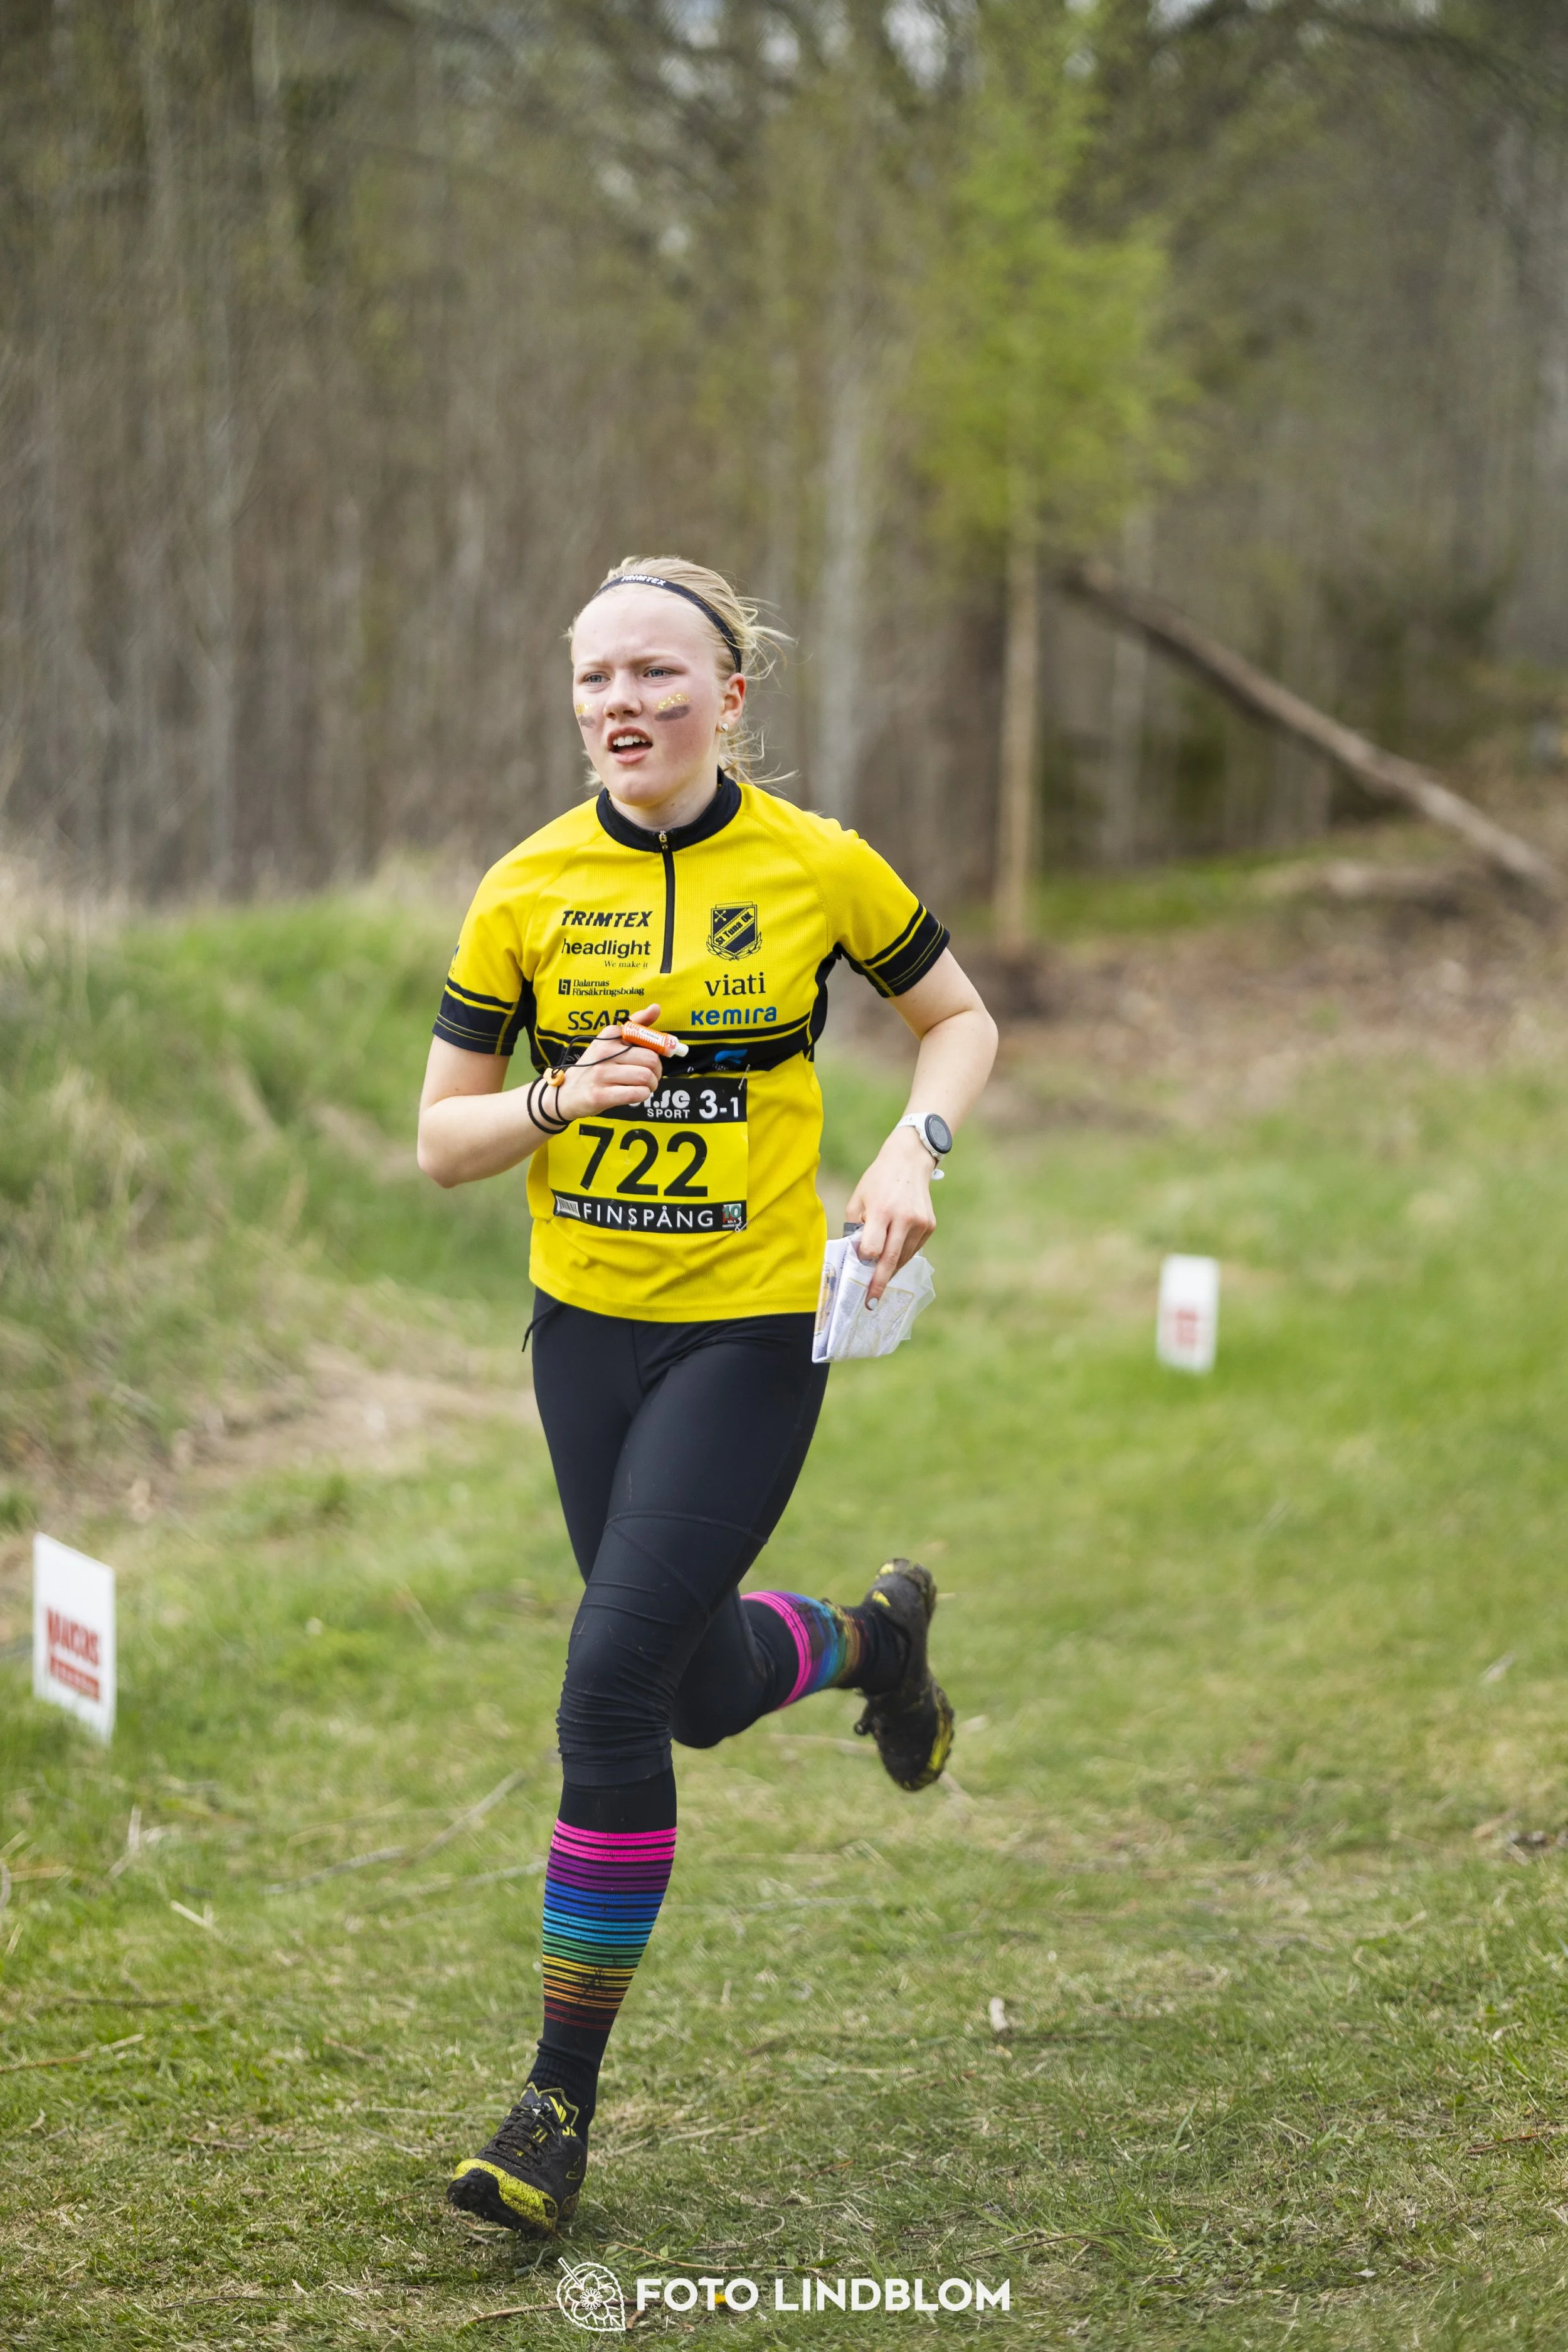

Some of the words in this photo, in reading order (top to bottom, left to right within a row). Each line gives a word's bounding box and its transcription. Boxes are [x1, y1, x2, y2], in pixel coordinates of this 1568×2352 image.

[561, 910, 653, 928] TRIMTEX
[723, 921, 743, 938] Tuna
[741, 911, 754, 923] OK
[561, 938, 652, 958] headlight
[618, 960, 641, 968] make
[573, 978, 610, 987] Dalarnas
[704, 972, 766, 997] viati
[572, 987, 645, 997] Försäkringsbolag
[647, 1108, 690, 1119] SPORT
[579, 1123, 708, 1197] 722
[583, 1202, 713, 1229] FINSPÅNG
[722, 1204, 742, 1220] 10
